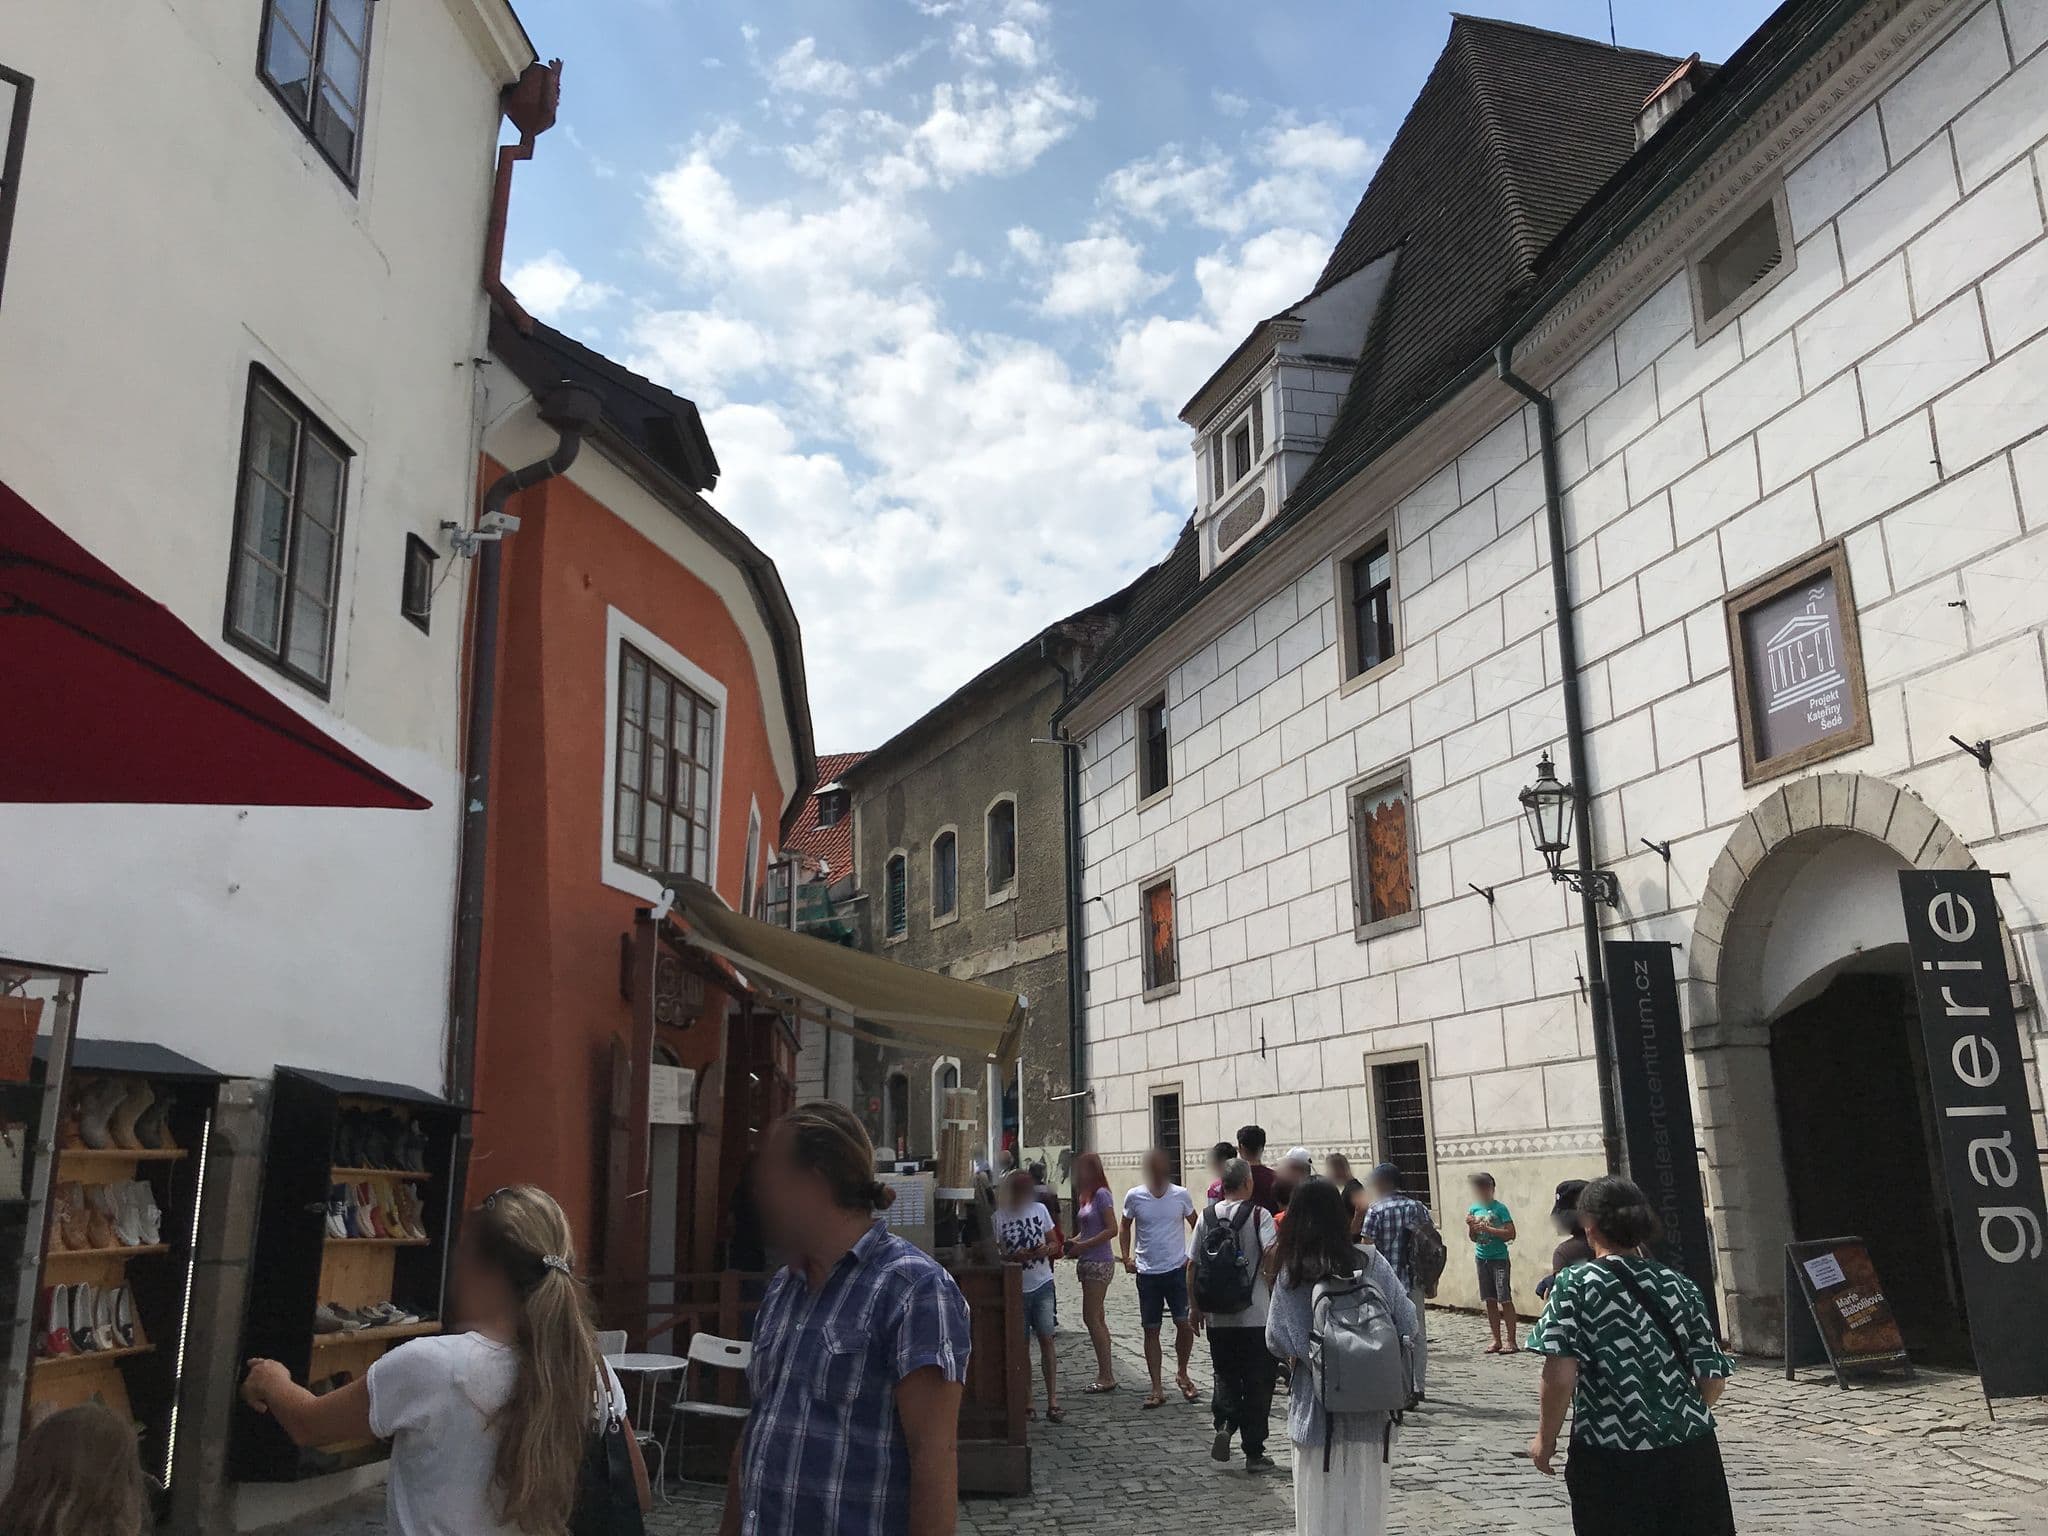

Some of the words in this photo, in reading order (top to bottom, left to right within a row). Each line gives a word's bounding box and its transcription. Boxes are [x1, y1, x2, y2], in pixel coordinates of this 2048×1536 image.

[1768, 627, 1835, 692] UNES-CO
[1809, 689, 1839, 709] Projekt
[1807, 703, 1841, 723] Kateřiny
[1820, 715, 1843, 731] Šedé
[1922, 891, 2043, 1264] galerie
